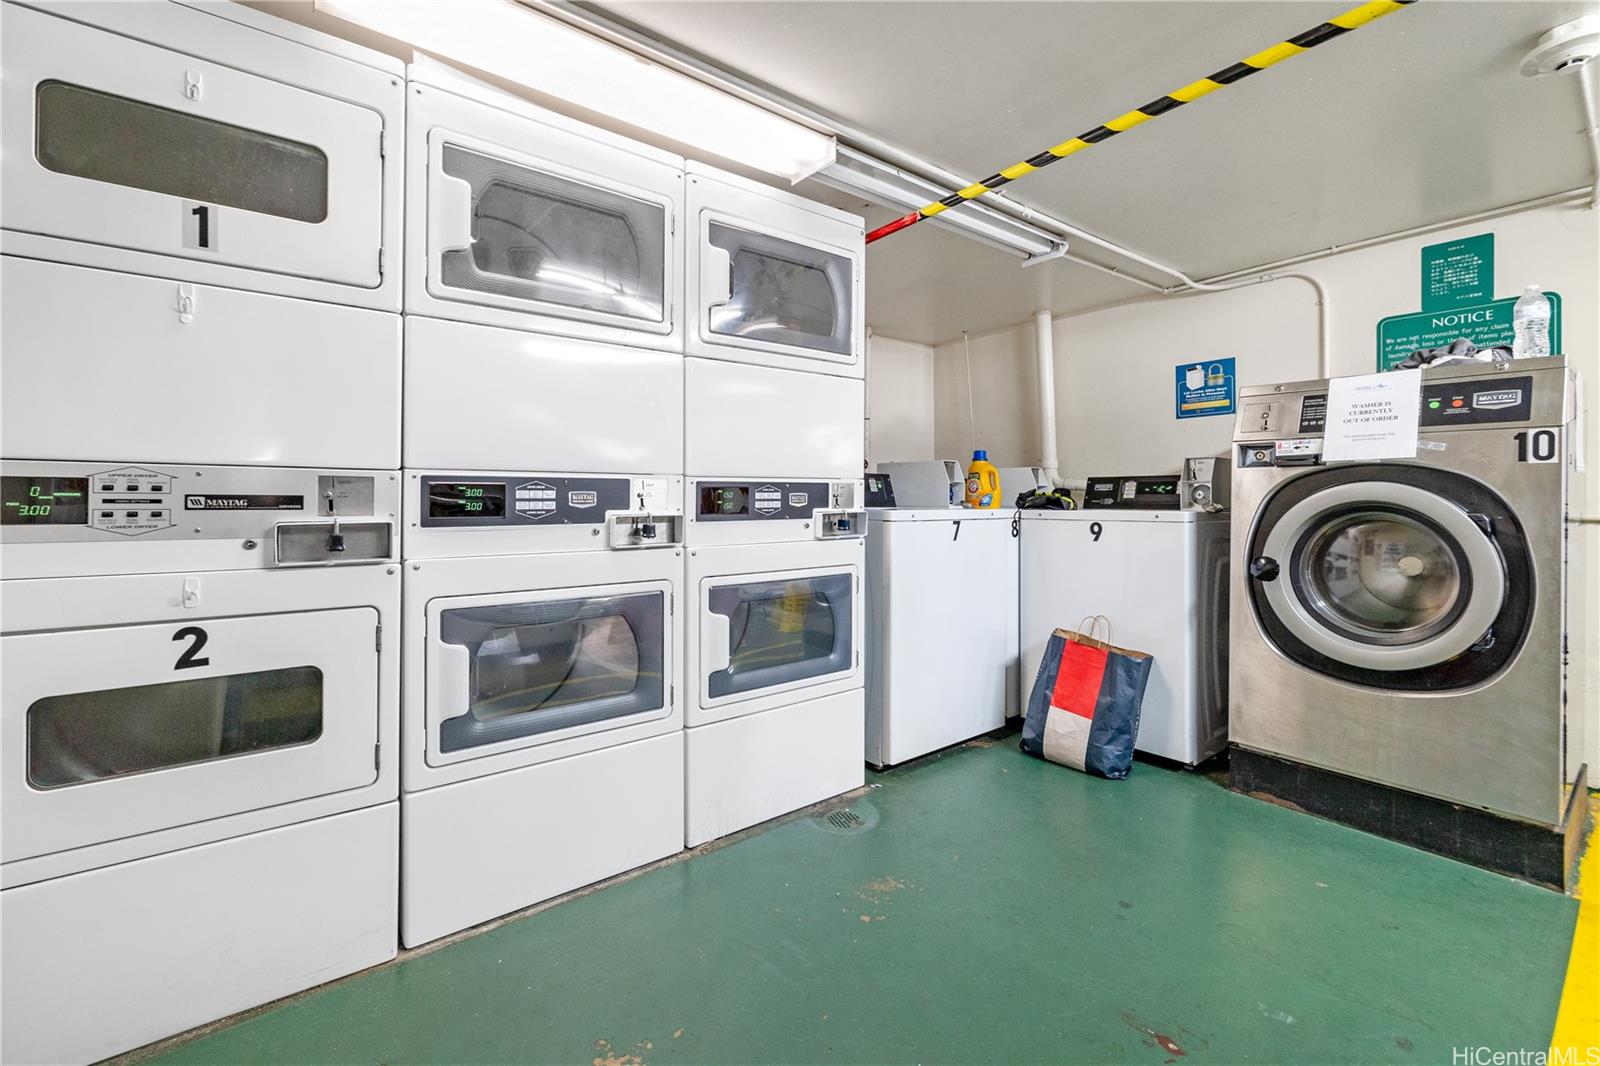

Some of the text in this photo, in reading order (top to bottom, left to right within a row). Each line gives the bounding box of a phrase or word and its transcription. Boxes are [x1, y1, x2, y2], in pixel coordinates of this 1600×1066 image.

[192, 205, 209, 248] 1
[1432, 309, 1494, 328] NOTICE
[1422, 328, 1459, 340] responsible
[1475, 325, 1489, 333] any
[1490, 322, 1510, 330] claim
[1478, 332, 1498, 340] items
[1387, 351, 1411, 359] laundry
[1478, 392, 1517, 401] MAYTAG
[1348, 407, 1394, 416] CURRENTLY
[1513, 429, 1556, 462] 10
[464, 488, 483, 498] 3.00
[18, 505, 51, 516] 3.00
[464, 502, 483, 511] 3.00
[952, 520, 961, 541] 7
[1011, 520, 1019, 538] 8
[1089, 521, 1103, 542] 9
[171, 626, 210, 671] 2
